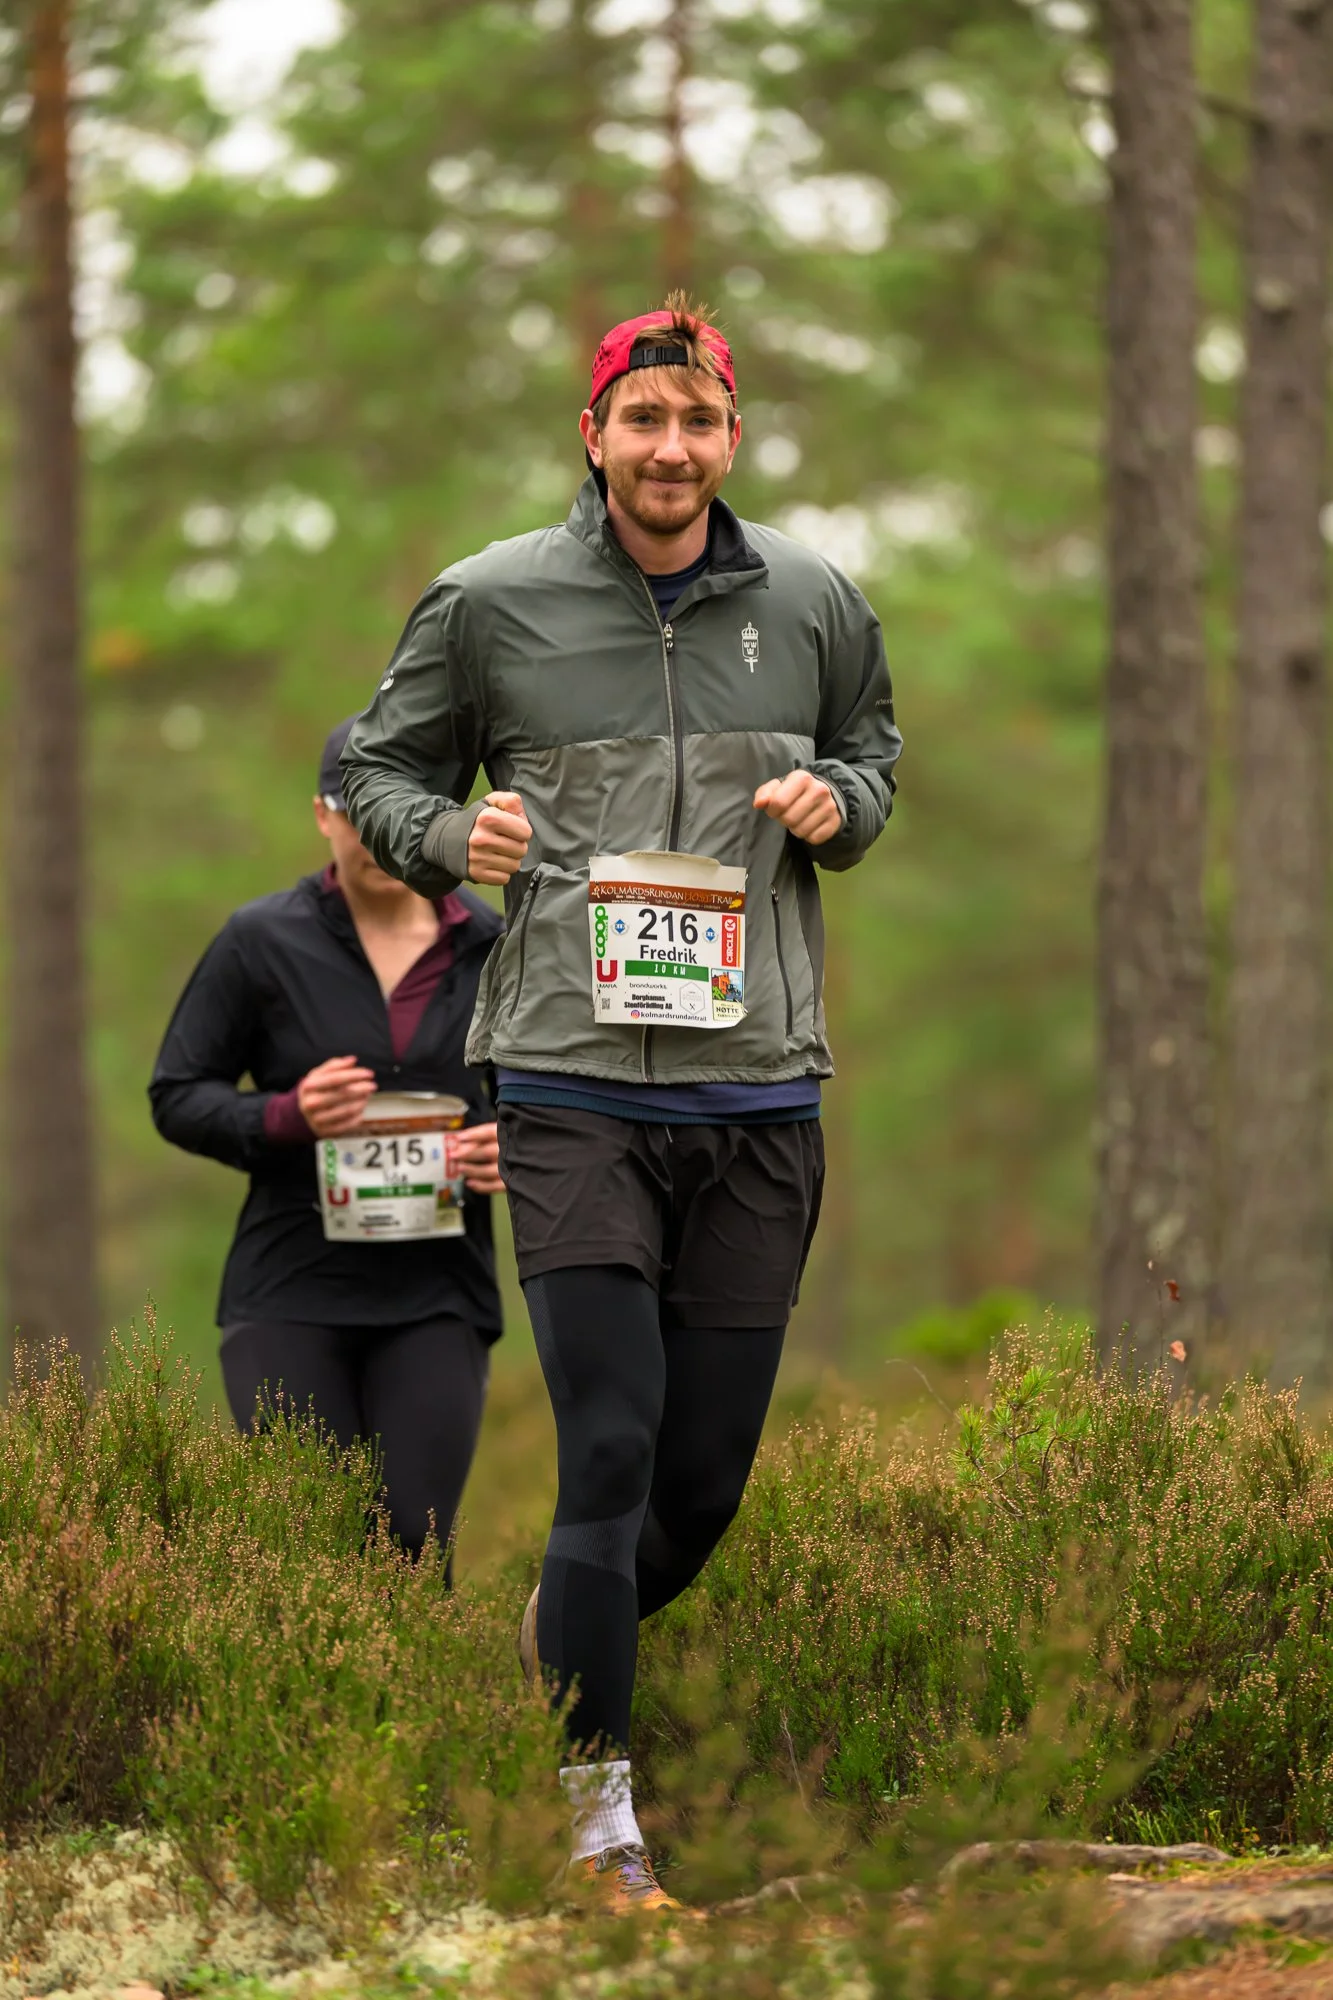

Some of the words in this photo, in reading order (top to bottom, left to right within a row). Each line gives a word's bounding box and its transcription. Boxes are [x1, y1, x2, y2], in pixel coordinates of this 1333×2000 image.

[594, 905, 608, 958] coop
[637, 908, 698, 945] 216
[640, 944, 698, 965] Fredrik
[726, 933, 734, 963] CIRCLE
[596, 960, 618, 982] U
[654, 963, 667, 974] 10
[673, 965, 686, 976] KM
[640, 1011, 707, 1022] kolmardsrundantrail
[364, 1138, 425, 1169] 215
